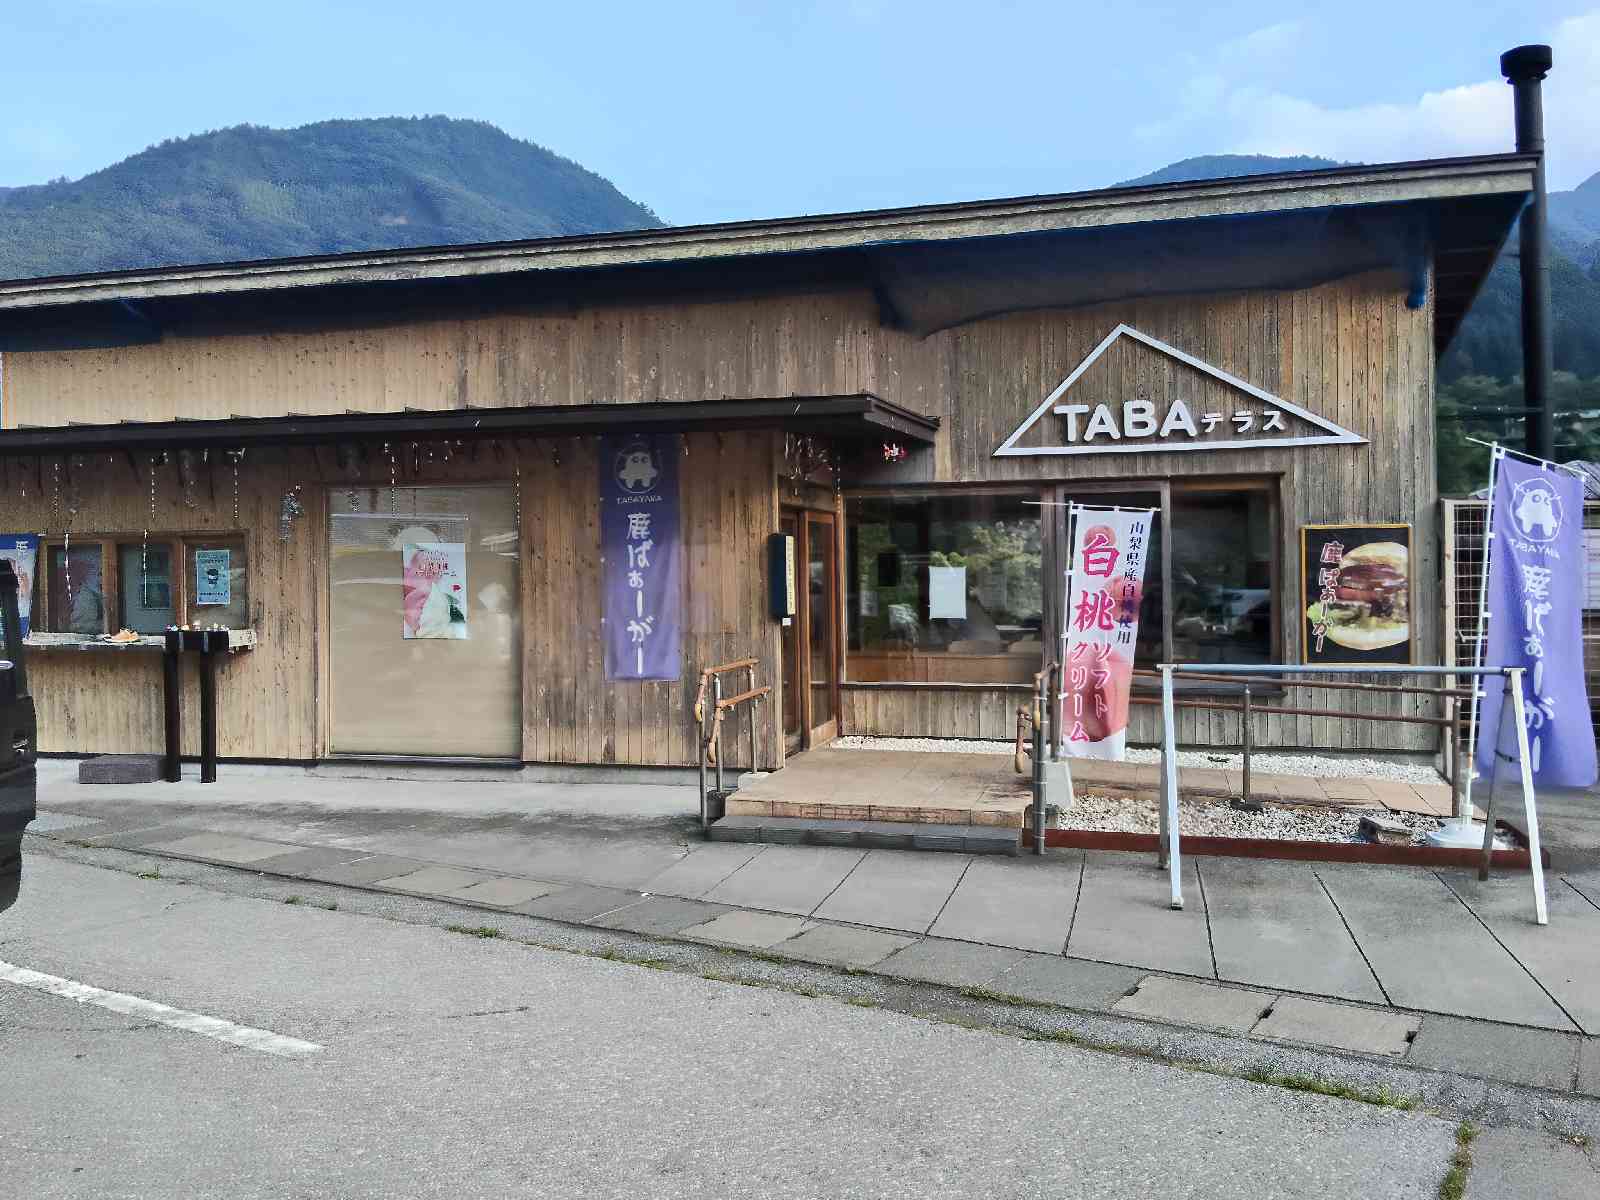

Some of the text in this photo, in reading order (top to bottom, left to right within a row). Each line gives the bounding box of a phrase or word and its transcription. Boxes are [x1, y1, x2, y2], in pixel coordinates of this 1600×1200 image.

[1054, 400, 1285, 441] TABA テラス
[1073, 533, 1120, 632] 白桃
[1508, 539, 1560, 560] TABAYMA
[1071, 641, 1089, 741] クリーム
[1091, 642, 1112, 720] ソフト
